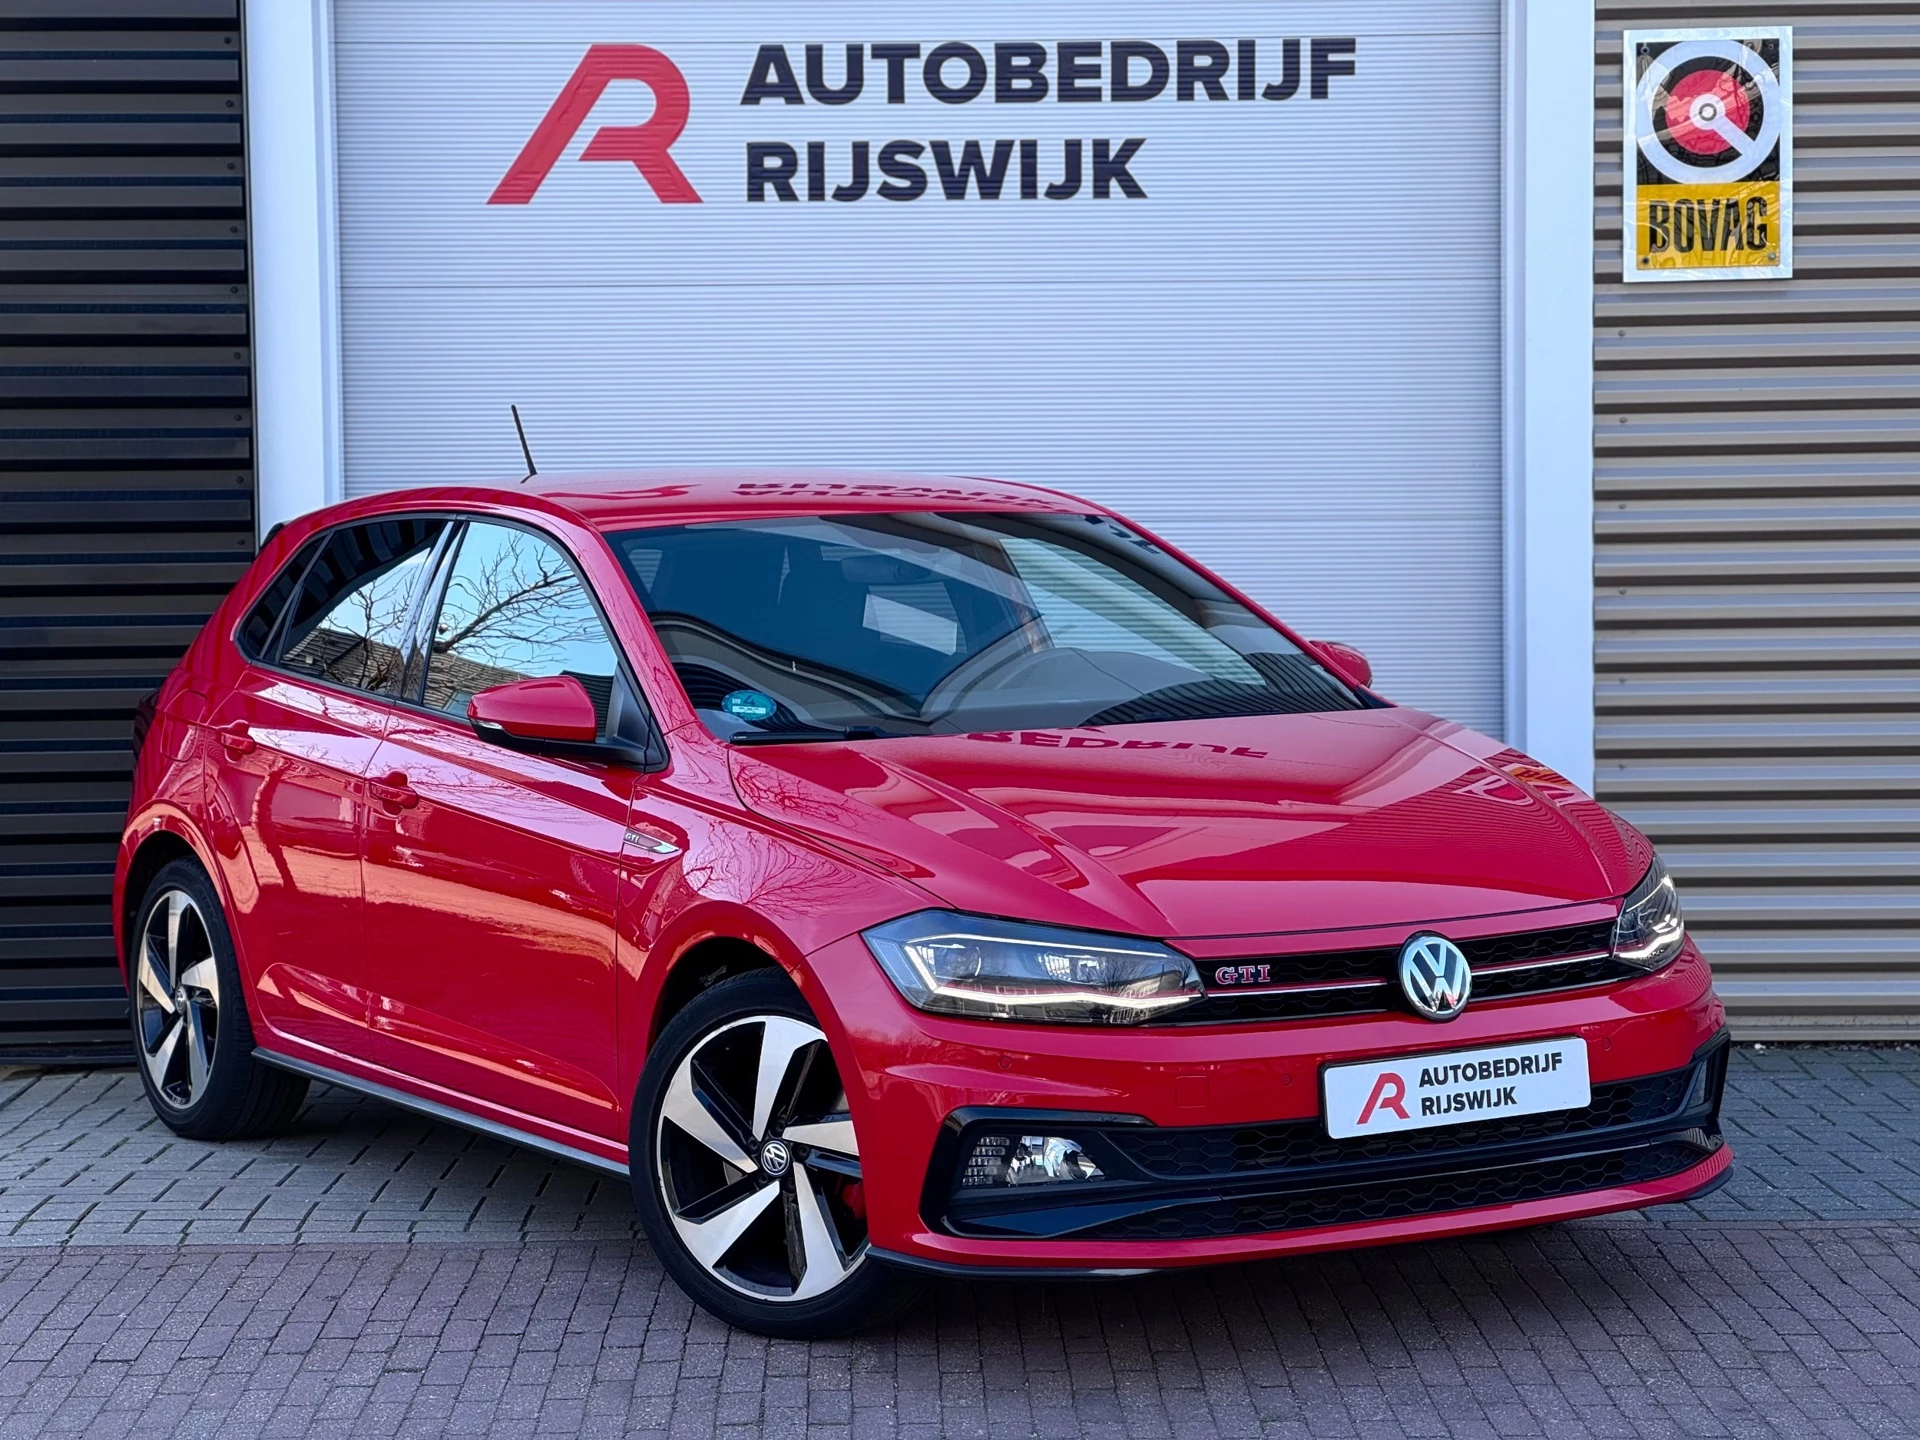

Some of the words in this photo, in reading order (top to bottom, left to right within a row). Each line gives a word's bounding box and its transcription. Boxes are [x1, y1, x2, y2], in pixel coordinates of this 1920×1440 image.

[740, 37, 1357, 106] AUTOBEDRIJF
[746, 138, 1148, 202] RIJSWIJK
[1648, 195, 1769, 254] BOVAG
[625, 832, 640, 843] GTI
[1215, 964, 1271, 985] GTI
[1418, 1052, 1563, 1088] AUTOBEDRIJF
[1421, 1086, 1518, 1117] RIJSWIJK
